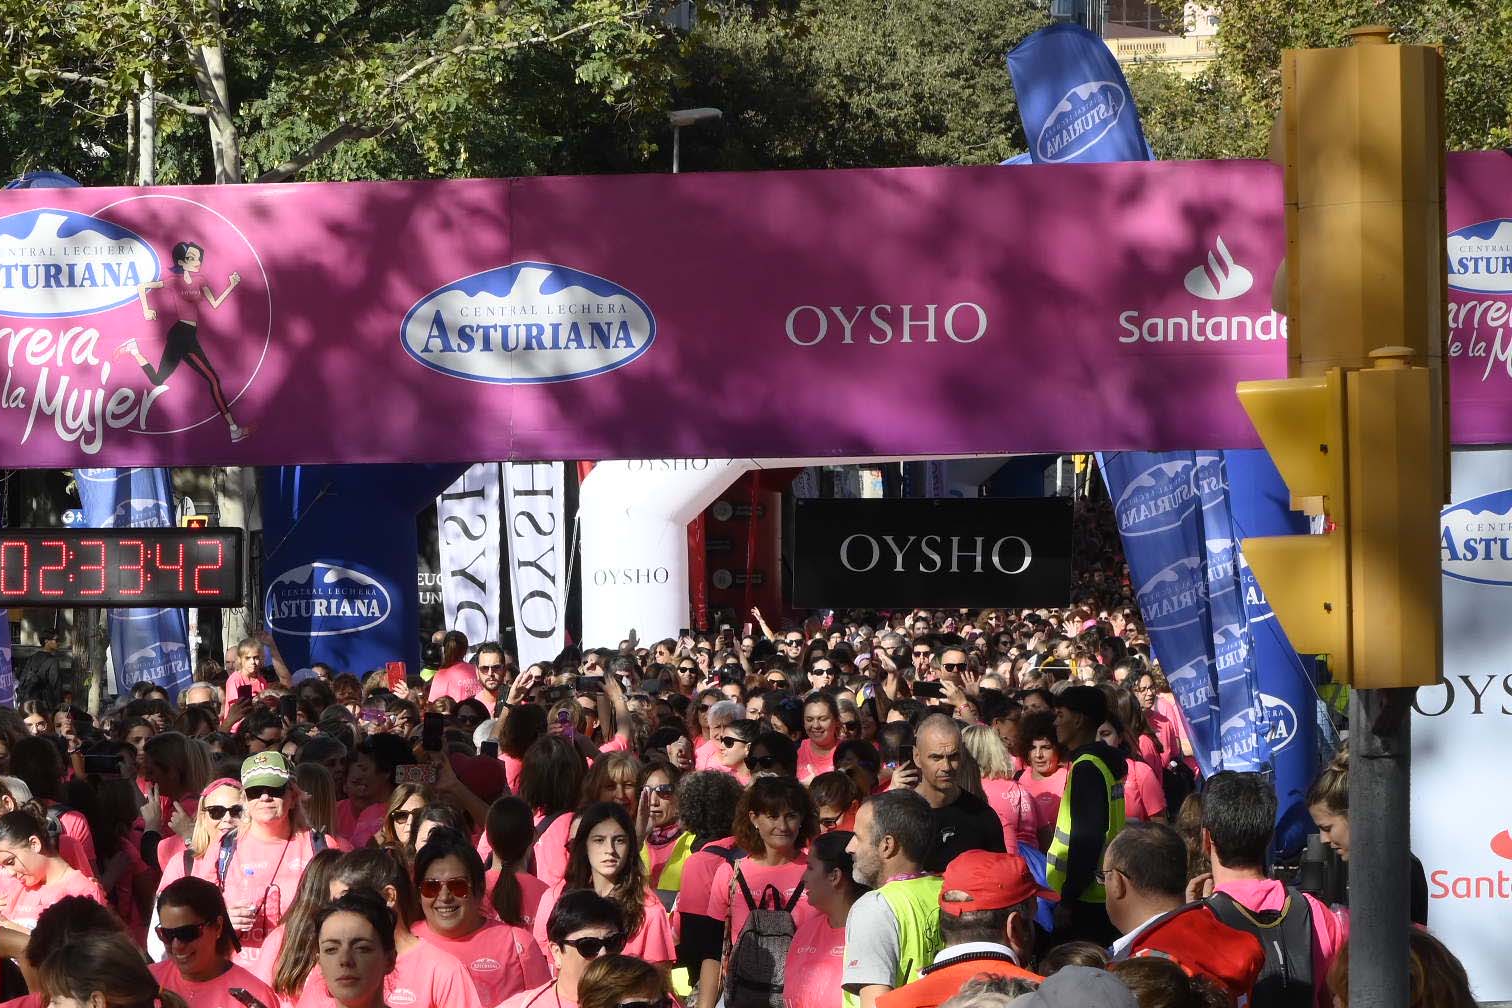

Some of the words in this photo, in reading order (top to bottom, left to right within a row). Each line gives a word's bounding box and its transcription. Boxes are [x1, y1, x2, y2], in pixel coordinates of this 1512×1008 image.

[63, 245, 135, 256] LECHERA
[1448, 256, 1512, 274] STUR
[459, 305, 539, 318] CENTRAL
[547, 303, 627, 316] LECHERA
[785, 302, 988, 347] OYSHO
[1448, 300, 1512, 328] arre
[420, 309, 635, 353] ASTURIANA
[1118, 310, 1288, 344] Santande
[1469, 329, 1487, 357] la
[1482, 327, 1512, 382] M
[1, 371, 26, 410] la
[21, 361, 170, 454] Mujer
[1, 541, 223, 595] 02:33:42
[840, 533, 1033, 575] OYSHO
[594, 566, 669, 586] OYSHO
[269, 592, 382, 620] ASTURIANA
[328, 588, 377, 596] LECHERA
[1430, 870, 1512, 900] Sant
